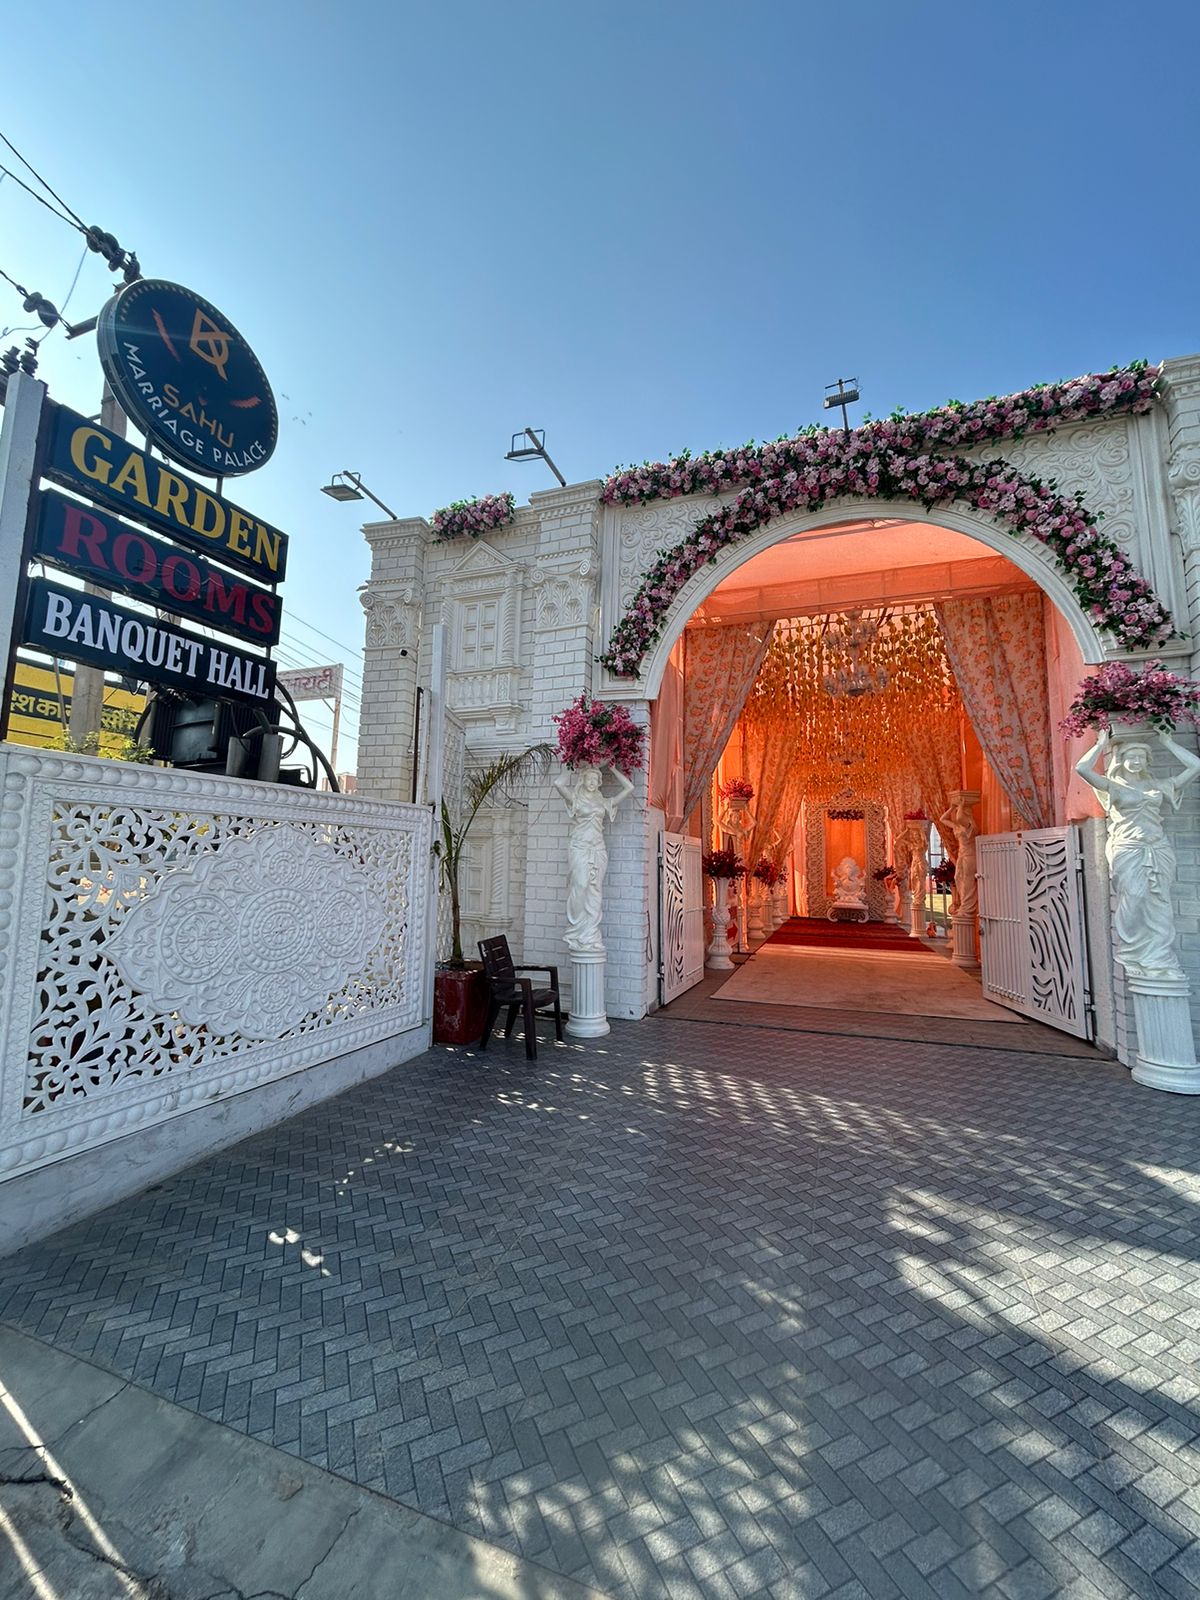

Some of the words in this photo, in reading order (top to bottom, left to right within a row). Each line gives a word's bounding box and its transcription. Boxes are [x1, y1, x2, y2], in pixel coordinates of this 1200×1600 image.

[123, 342, 204, 455] MARRIAGE
[212, 440, 267, 467] PALACE
[163, 383, 235, 448] SAHU
[70, 426, 283, 572] GARDEN
[57, 503, 276, 634] ROOMS
[42, 591, 204, 678] BANQUET
[206, 647, 270, 700] HALL
